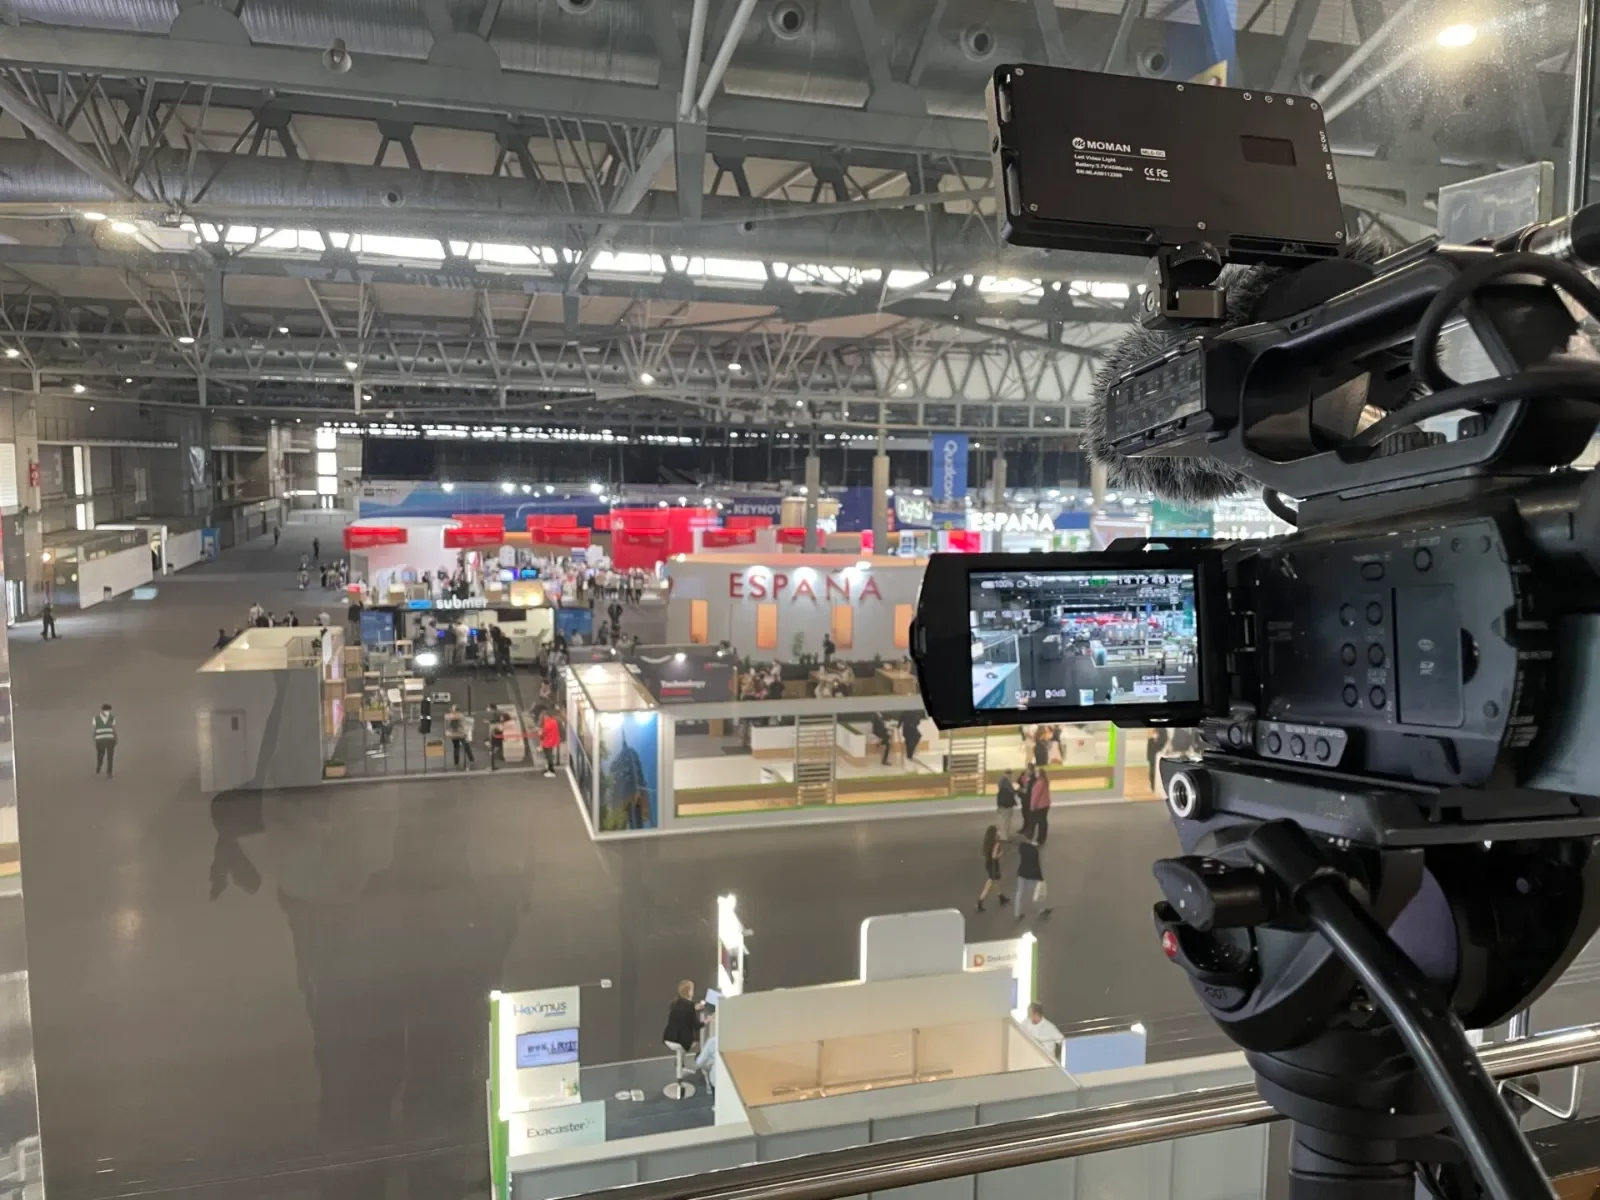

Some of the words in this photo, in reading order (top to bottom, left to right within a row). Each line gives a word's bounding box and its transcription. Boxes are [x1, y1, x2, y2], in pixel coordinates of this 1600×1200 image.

[1087, 140, 1132, 153] MOMAN
[943, 439, 959, 501] Qualcom
[733, 503, 781, 515] KEYNOT
[971, 504, 1056, 532] ESPAÑA
[729, 569, 884, 603] ESPAÑA
[436, 594, 488, 609] submer
[526, 1122, 586, 1138] Exacaster
